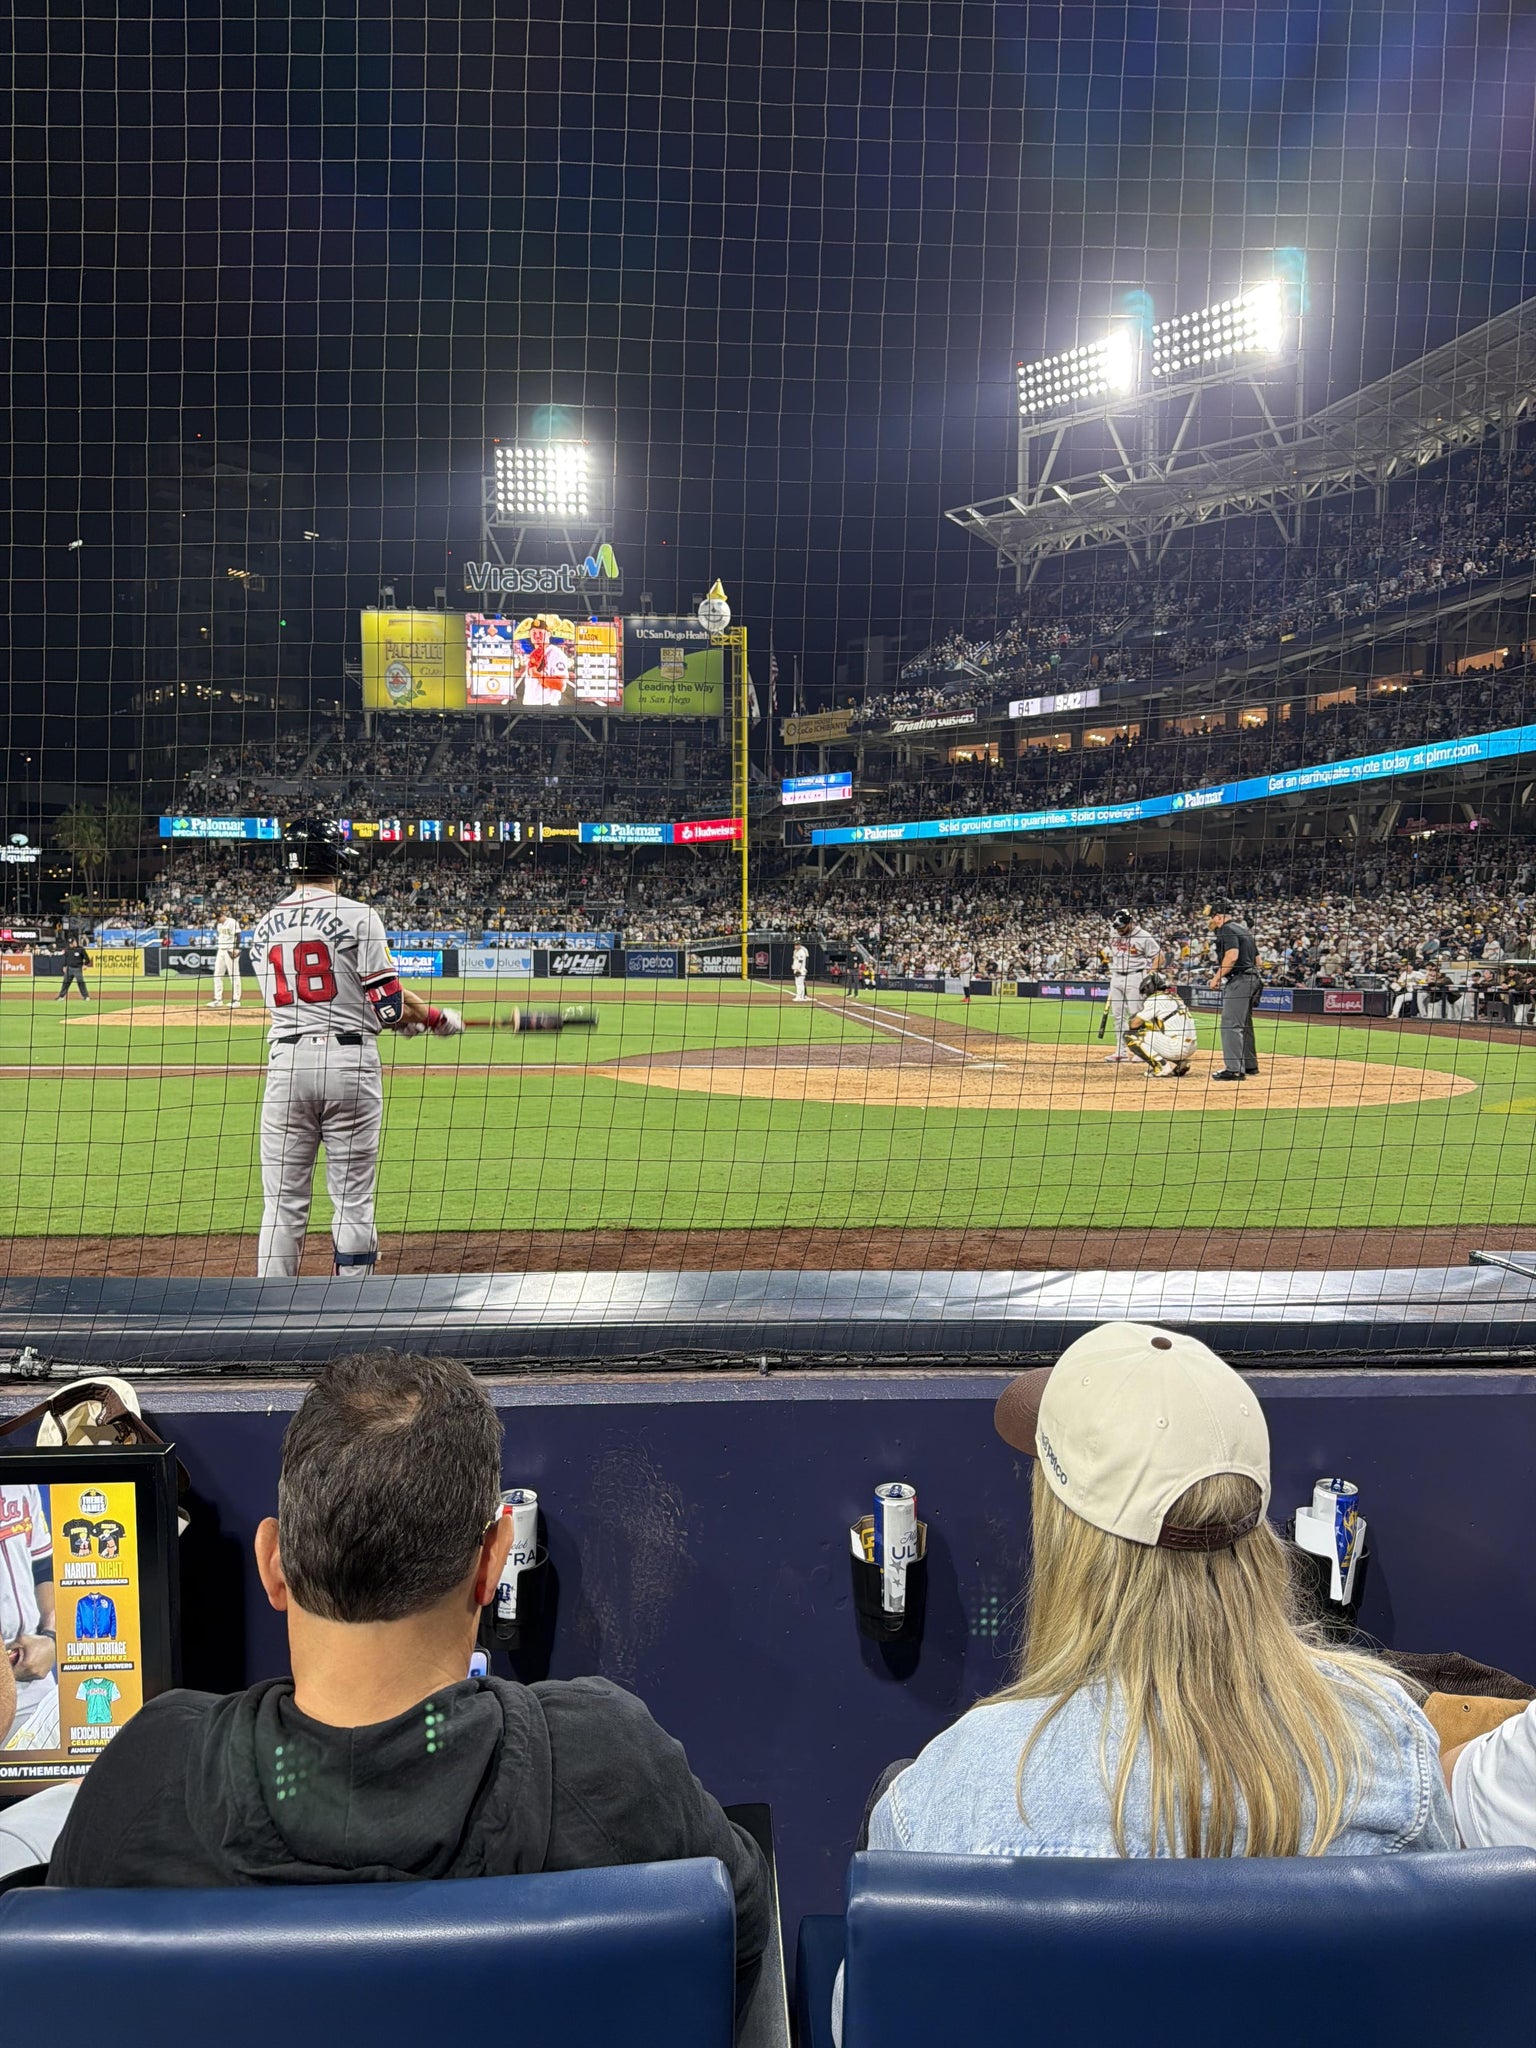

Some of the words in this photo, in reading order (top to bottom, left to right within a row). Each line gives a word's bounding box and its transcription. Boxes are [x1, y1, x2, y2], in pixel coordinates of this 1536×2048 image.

[467, 561, 576, 593] Viasat
[636, 630, 648, 639] UC
[649, 630, 663, 639] San
[664, 630, 685, 641] Diego
[686, 629, 709, 640] Health
[638, 682, 676, 694] Leading
[677, 682, 692, 692] the
[694, 683, 714, 692] Way
[638, 696, 646, 704] in
[649, 696, 666, 704] San
[668, 696, 690, 705] Diego
[1056, 693, 1081, 712] 9:42
[890, 719, 936, 734] Tarantino
[936, 713, 974, 728] SAUSAGES
[1268, 778, 1285, 791] Get
[1286, 777, 1297, 788] an
[1298, 766, 1350, 786] earthquake
[1352, 762, 1380, 778] quote
[1382, 756, 1410, 773] today
[1413, 754, 1424, 765] at
[1426, 743, 1482, 766] plmr.com.
[1184, 790, 1223, 808] Palomar
[191, 818, 245, 830] Palomar
[938, 822, 960, 832] Solid
[962, 819, 992, 832] ground
[994, 816, 1012, 828] isn't
[1014, 818, 1018, 826] a
[1020, 813, 1068, 828] guarantee.
[1070, 810, 1096, 822] Solid
[408, 824, 415, 836] F
[449, 826, 455, 837] F
[488, 826, 495, 837] F
[528, 826, 534, 838] F
[611, 824, 661, 836] Palomar
[864, 826, 904, 840] Palomar
[289, 852, 298, 862] 18
[95, 954, 139, 962] MERCURY
[461, 957, 484, 968] blue
[498, 957, 520, 968] blue
[642, 954, 674, 970] petco
[703, 956, 721, 966] SLAP
[5, 963, 26, 972] Park
[268, 940, 339, 1008] 18
[82, 1496, 104, 1504] THEME
[82, 1504, 106, 1512] GAMES
[64, 1562, 97, 1578] NARUTO
[98, 1562, 122, 1578] NIGHT
[67, 1642, 95, 1656] FILIPINO
[96, 1642, 126, 1654] HERITAGE
[71, 1727, 100, 1740] MEXICAN
